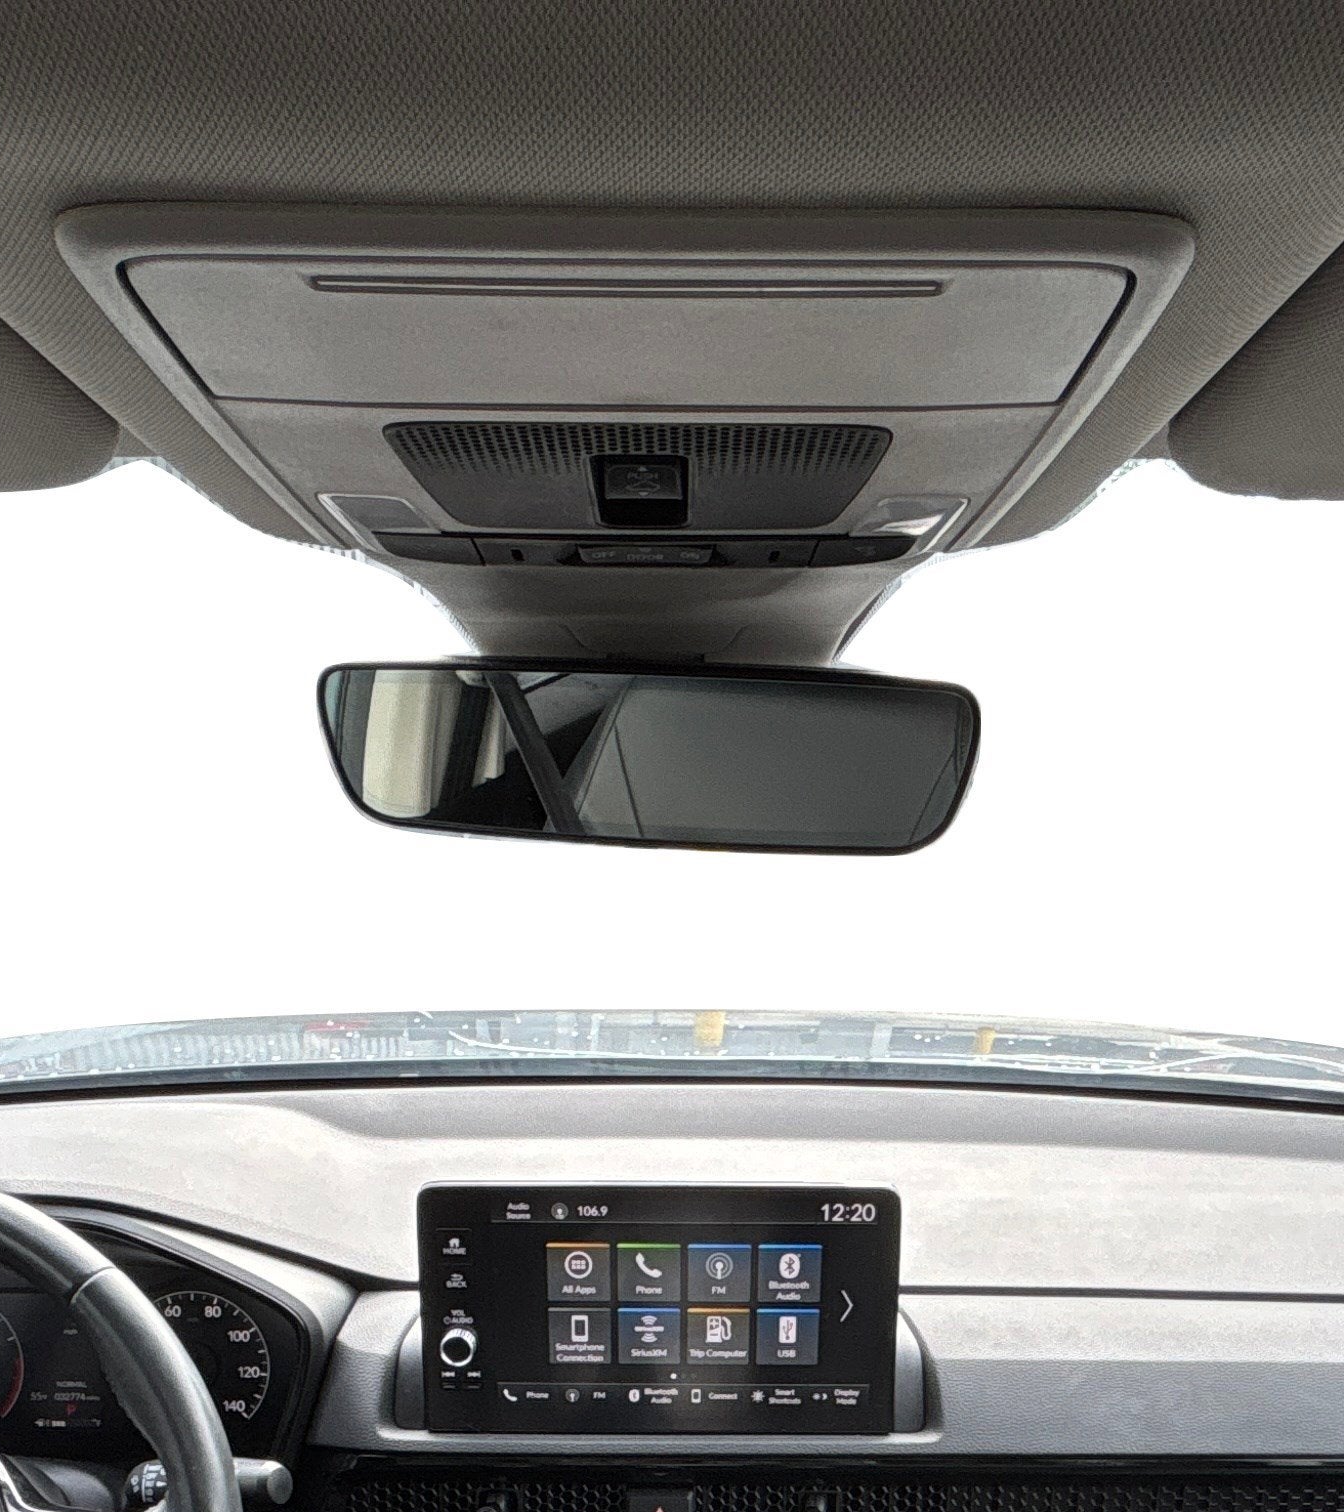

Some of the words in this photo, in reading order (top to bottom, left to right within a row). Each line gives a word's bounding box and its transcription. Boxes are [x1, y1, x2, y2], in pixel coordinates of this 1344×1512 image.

[506, 1202, 530, 1212] Audio
[576, 1205, 609, 1218] 106.9
[820, 1202, 877, 1223] 12:20
[561, 1285, 573, 1295] All
[574, 1285, 597, 1296] Apps
[635, 1285, 663, 1295] Phone
[711, 1285, 727, 1296] FM
[767, 1280, 810, 1291] Bluetooth
[775, 1291, 802, 1301] Audio
[164, 1306, 182, 1318] 60
[204, 1306, 222, 1318] 80
[227, 1330, 251, 1343] 100
[554, 1342, 606, 1353] Smartphone
[630, 1348, 668, 1358] SiriusXM
[555, 1353, 605, 1363] Connection
[688, 1349, 705, 1359] Trip
[705, 1349, 749, 1360] Computer
[777, 1349, 797, 1358] USB
[238, 1366, 261, 1379] 120
[525, 1391, 550, 1400] Phone
[223, 1400, 246, 1413] 140
